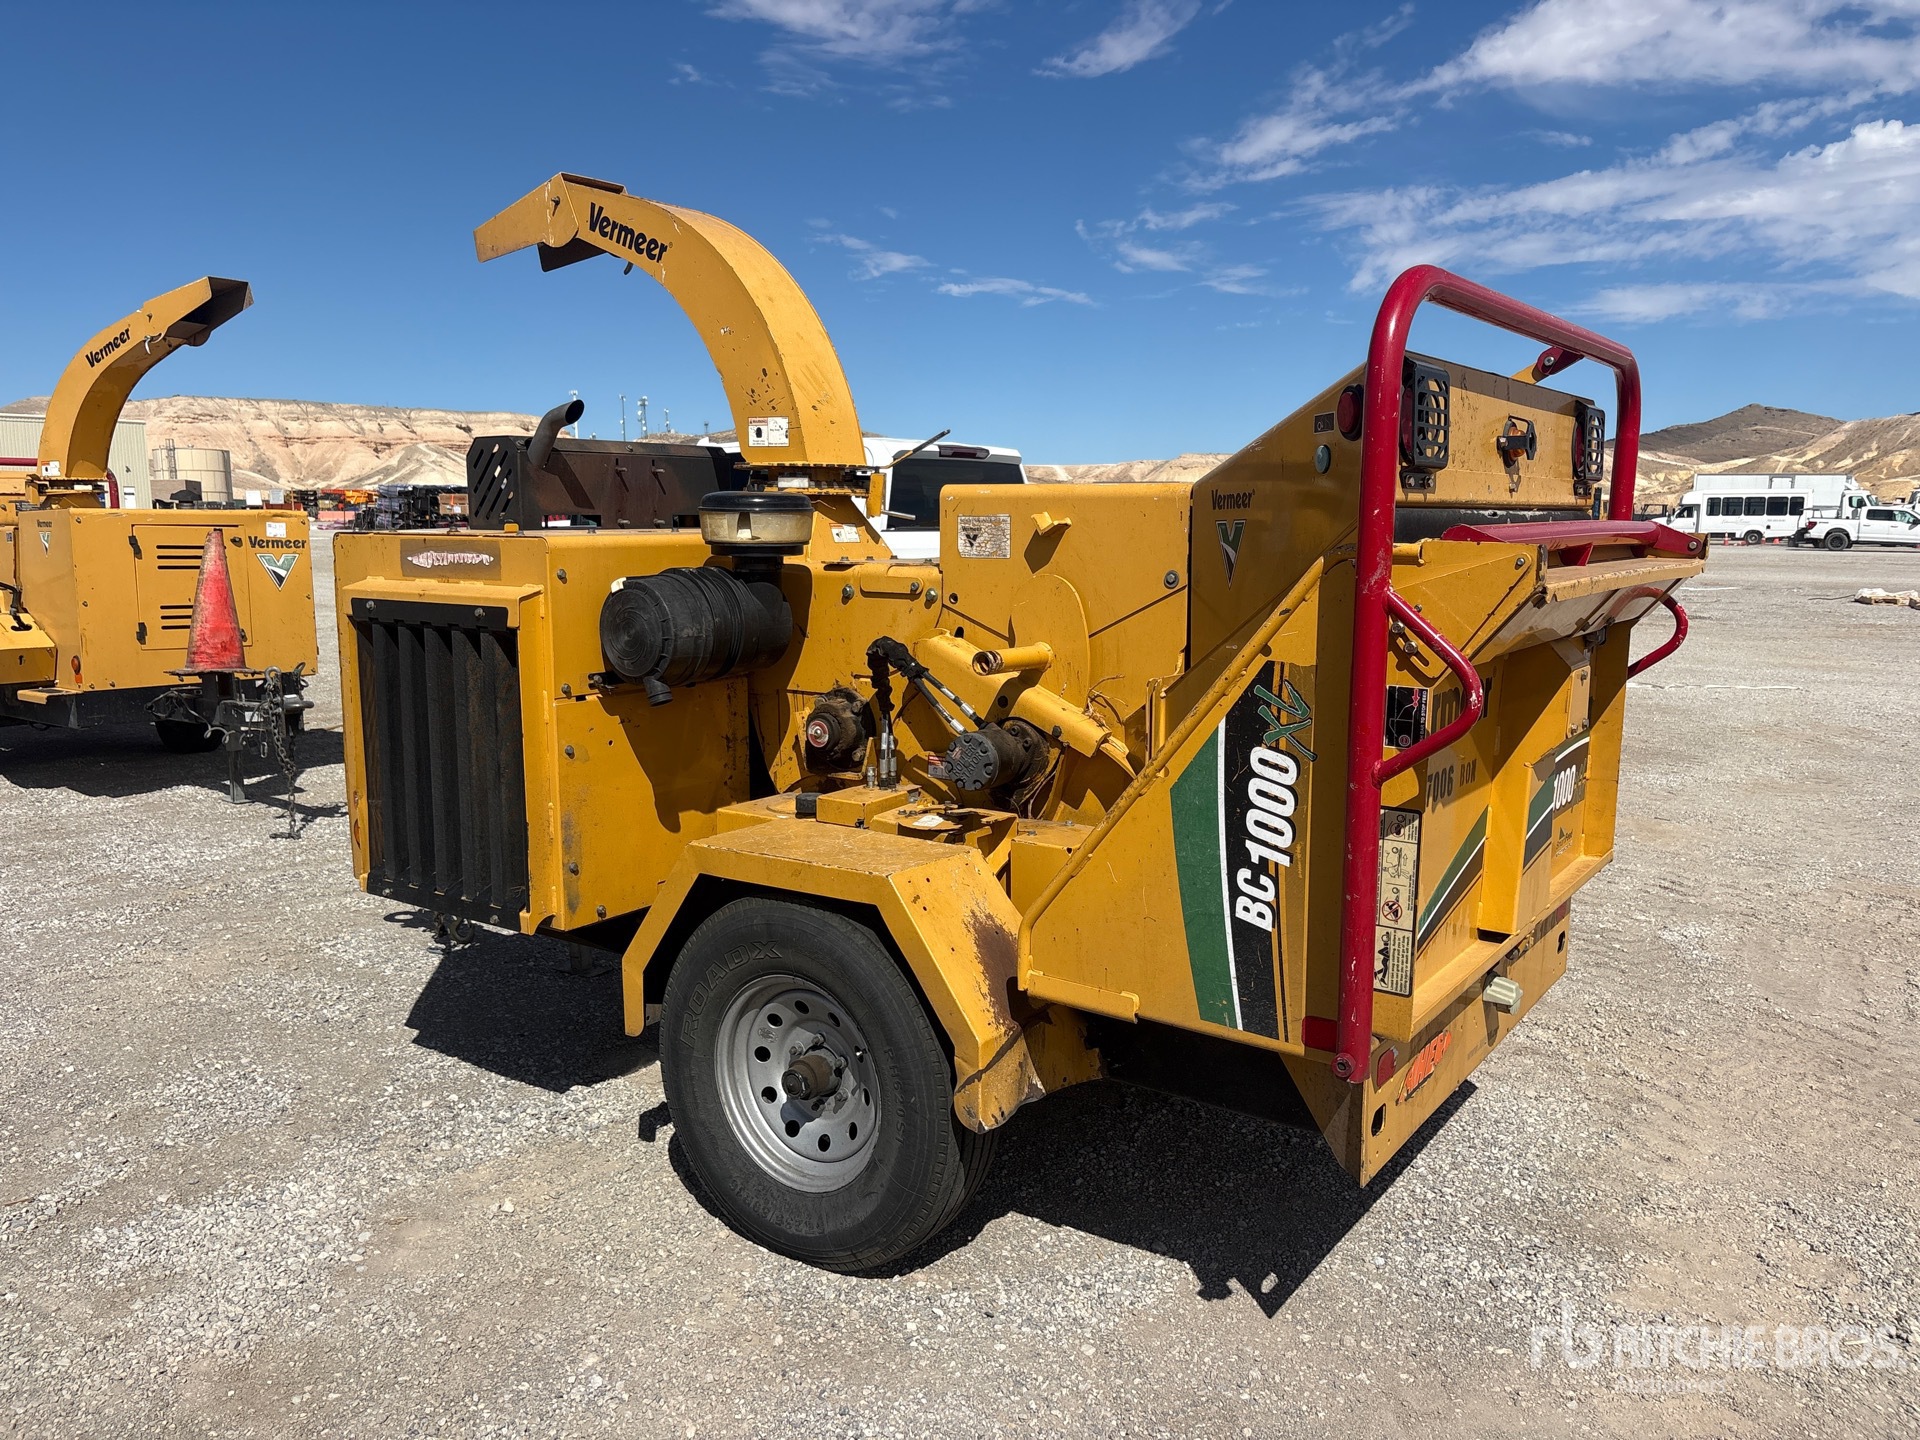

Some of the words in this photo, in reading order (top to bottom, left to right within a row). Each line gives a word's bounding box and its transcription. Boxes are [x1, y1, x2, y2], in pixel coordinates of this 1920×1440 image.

[589, 202, 668, 263] Vermeer
[85, 327, 131, 368] Vermeer
[1211, 489, 1252, 511] Vermeer
[248, 536, 306, 549] Vermeer
[680, 940, 783, 1049] ROADX
